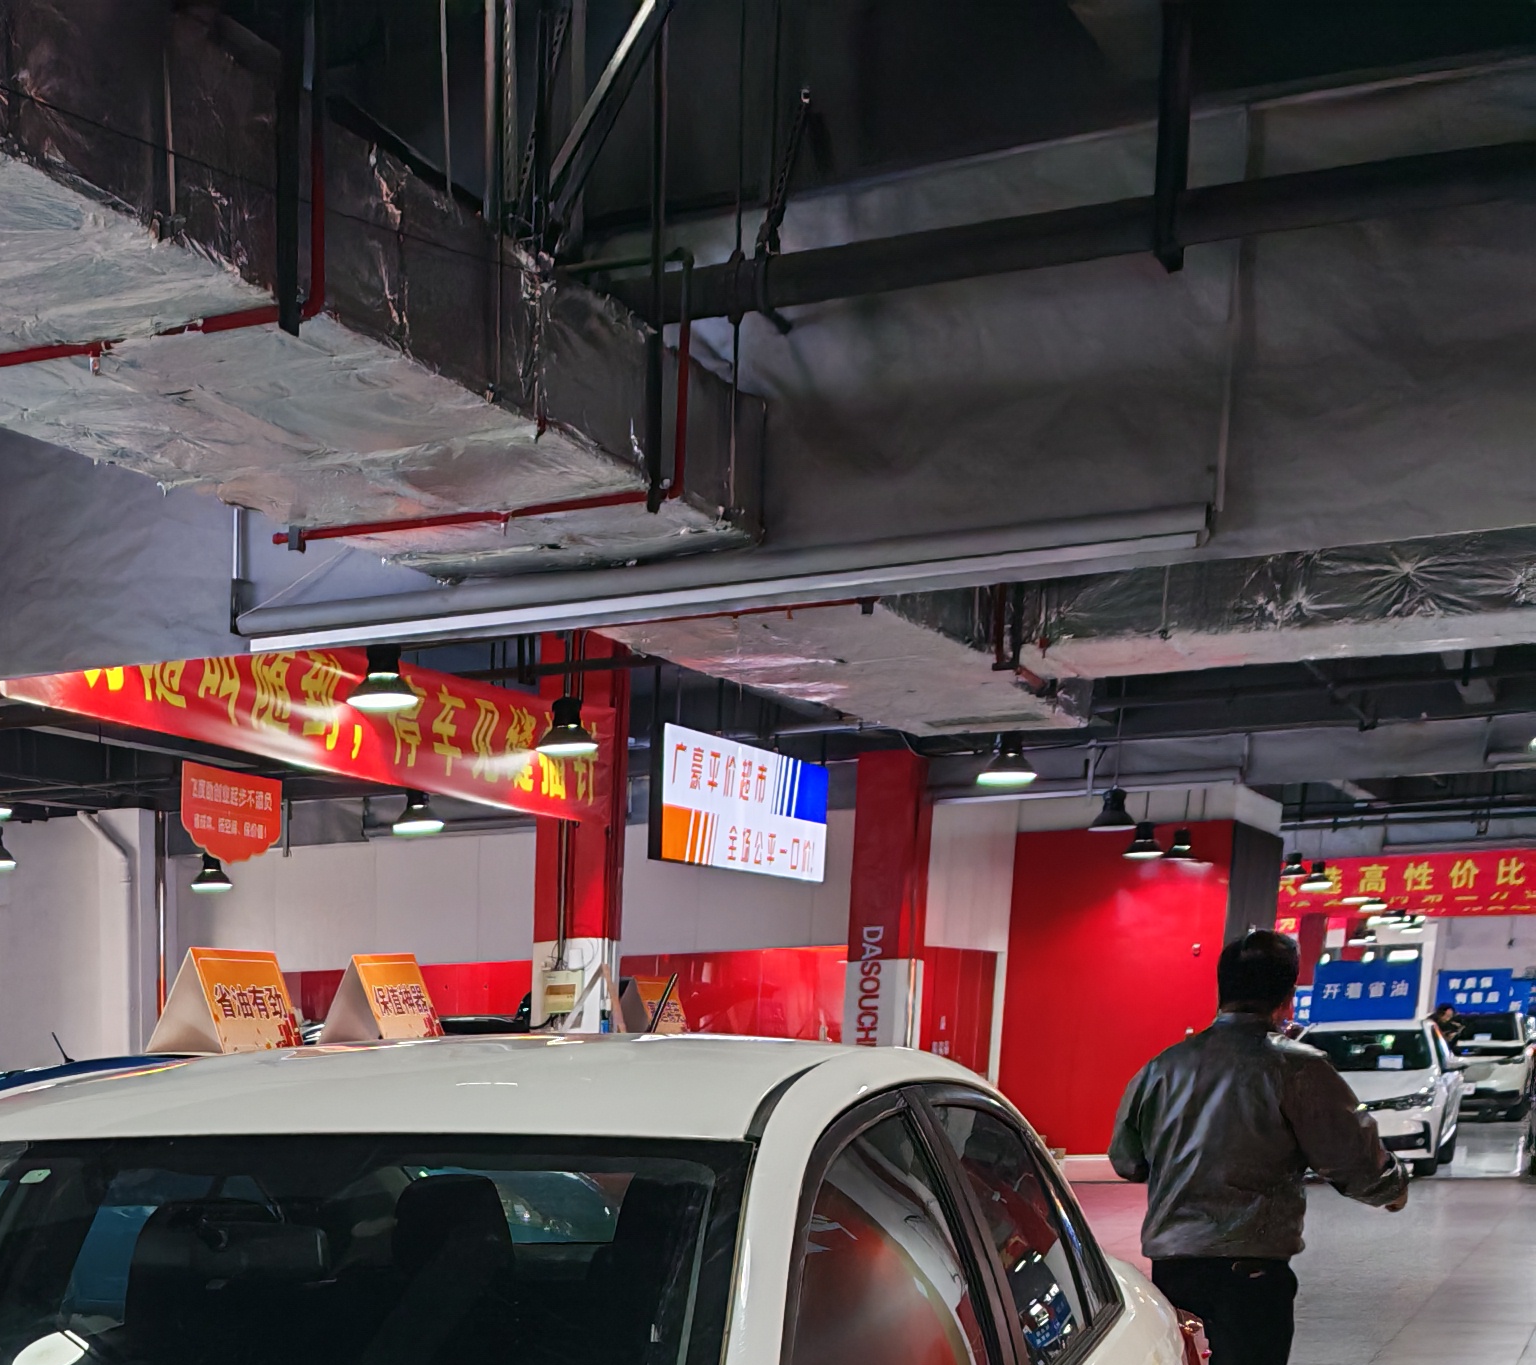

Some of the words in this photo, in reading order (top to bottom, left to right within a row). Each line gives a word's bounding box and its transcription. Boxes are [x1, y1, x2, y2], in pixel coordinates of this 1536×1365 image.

[672, 742, 768, 804] 广豪平价超市
[213, 983, 289, 1020] 省油有劲
[371, 983, 430, 1016] 保值神器
[1322, 980, 1410, 999] 开着省油
